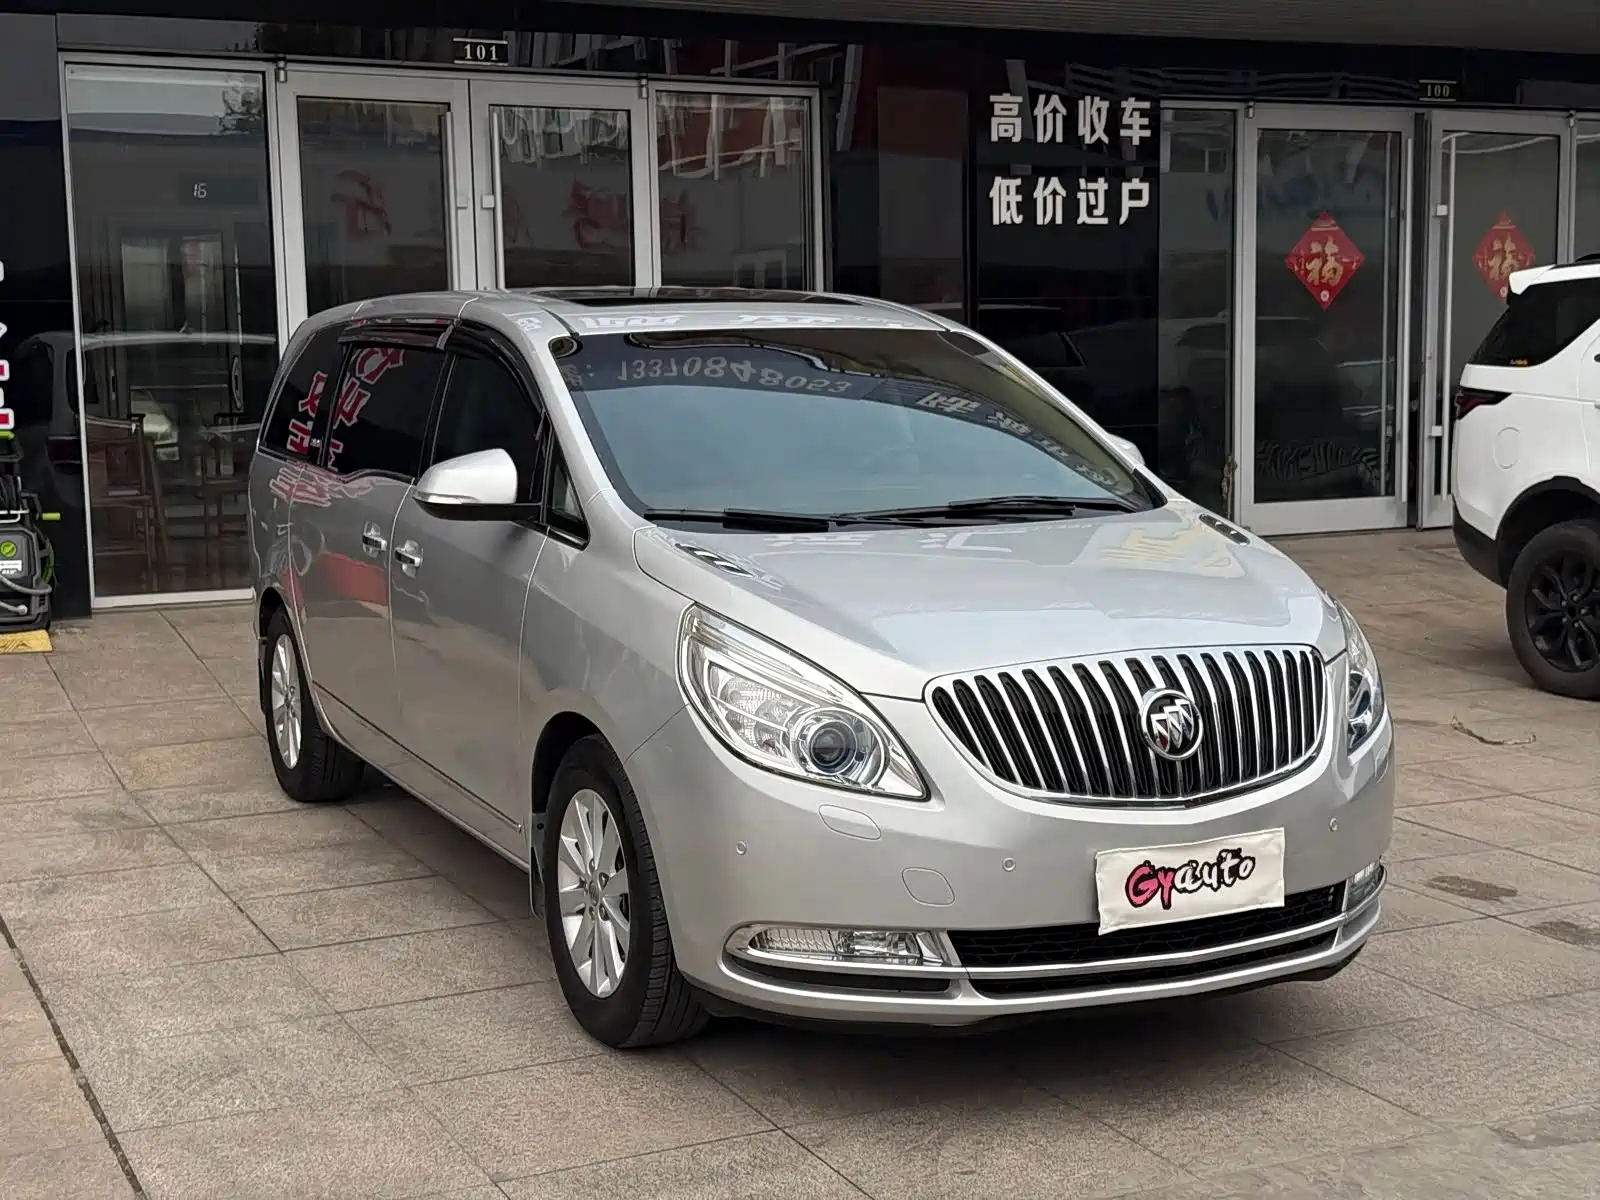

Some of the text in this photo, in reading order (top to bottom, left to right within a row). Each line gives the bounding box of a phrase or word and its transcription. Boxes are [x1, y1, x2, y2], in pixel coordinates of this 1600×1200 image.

[464, 43, 498, 60] 101
[1427, 84, 1450, 97] 100
[989, 93, 1151, 145] 高价收车
[989, 176, 1150, 225] 低价过户
[1305, 236, 1343, 286] 福
[1125, 848, 1256, 910] Gyauto
